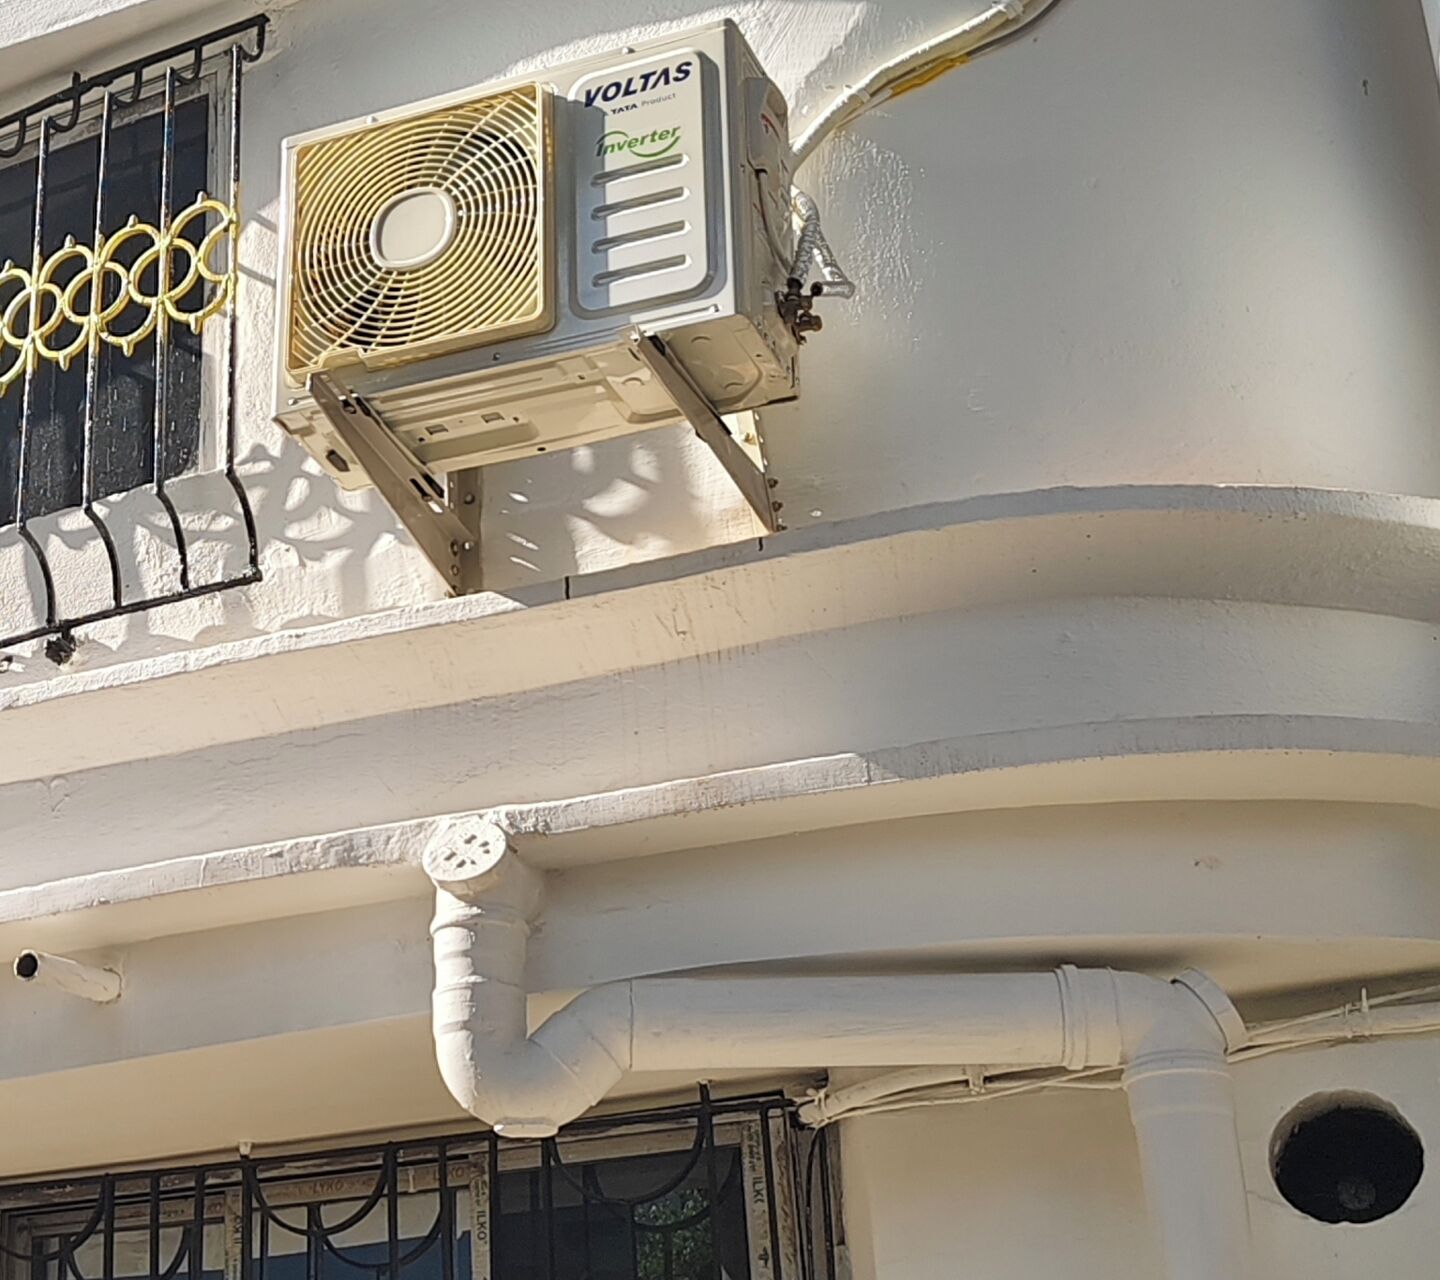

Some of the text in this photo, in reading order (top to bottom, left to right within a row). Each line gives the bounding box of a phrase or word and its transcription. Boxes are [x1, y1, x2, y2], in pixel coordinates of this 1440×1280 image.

[584, 61, 693, 108] VOLTAS
[610, 93, 676, 115] TATA Product
